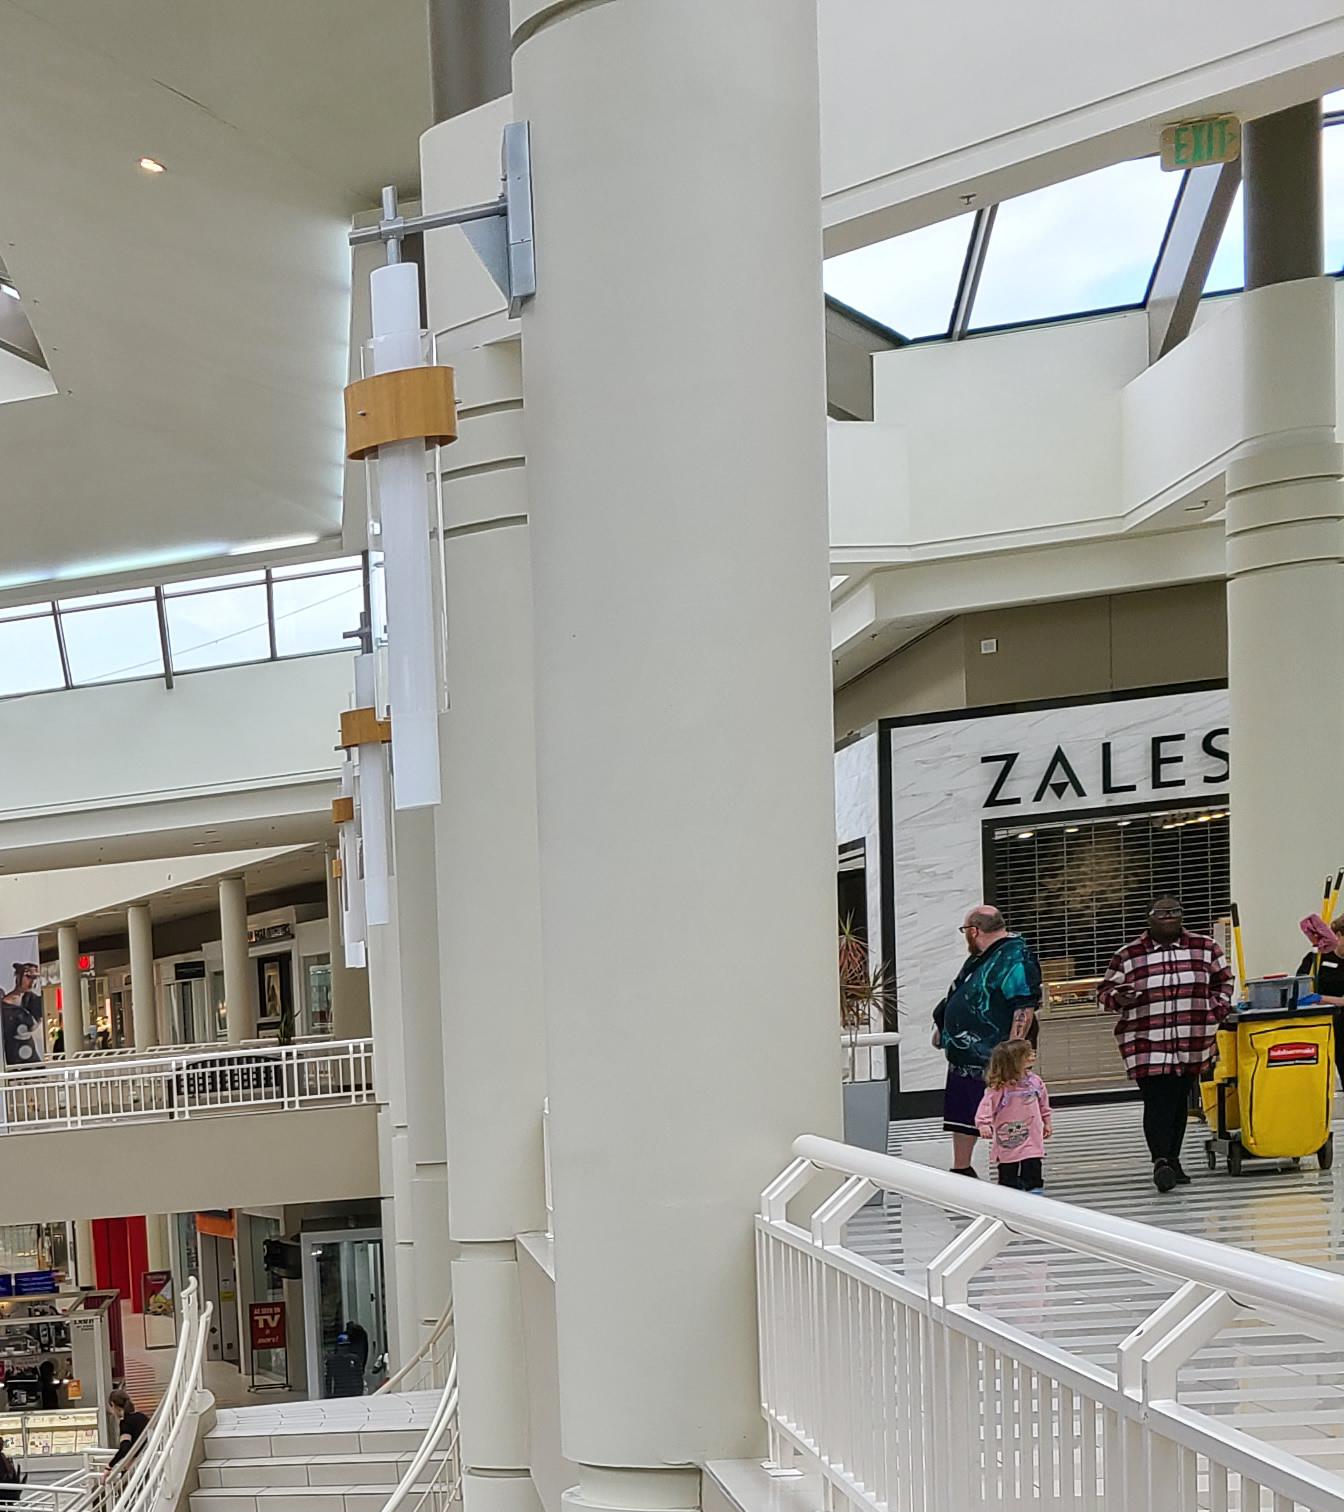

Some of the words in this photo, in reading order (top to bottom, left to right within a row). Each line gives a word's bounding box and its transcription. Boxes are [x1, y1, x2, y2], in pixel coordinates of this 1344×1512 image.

[1175, 120, 1230, 165] EXIT
[980, 728, 1229, 808] ZALES
[253, 1314, 281, 1329] TV
